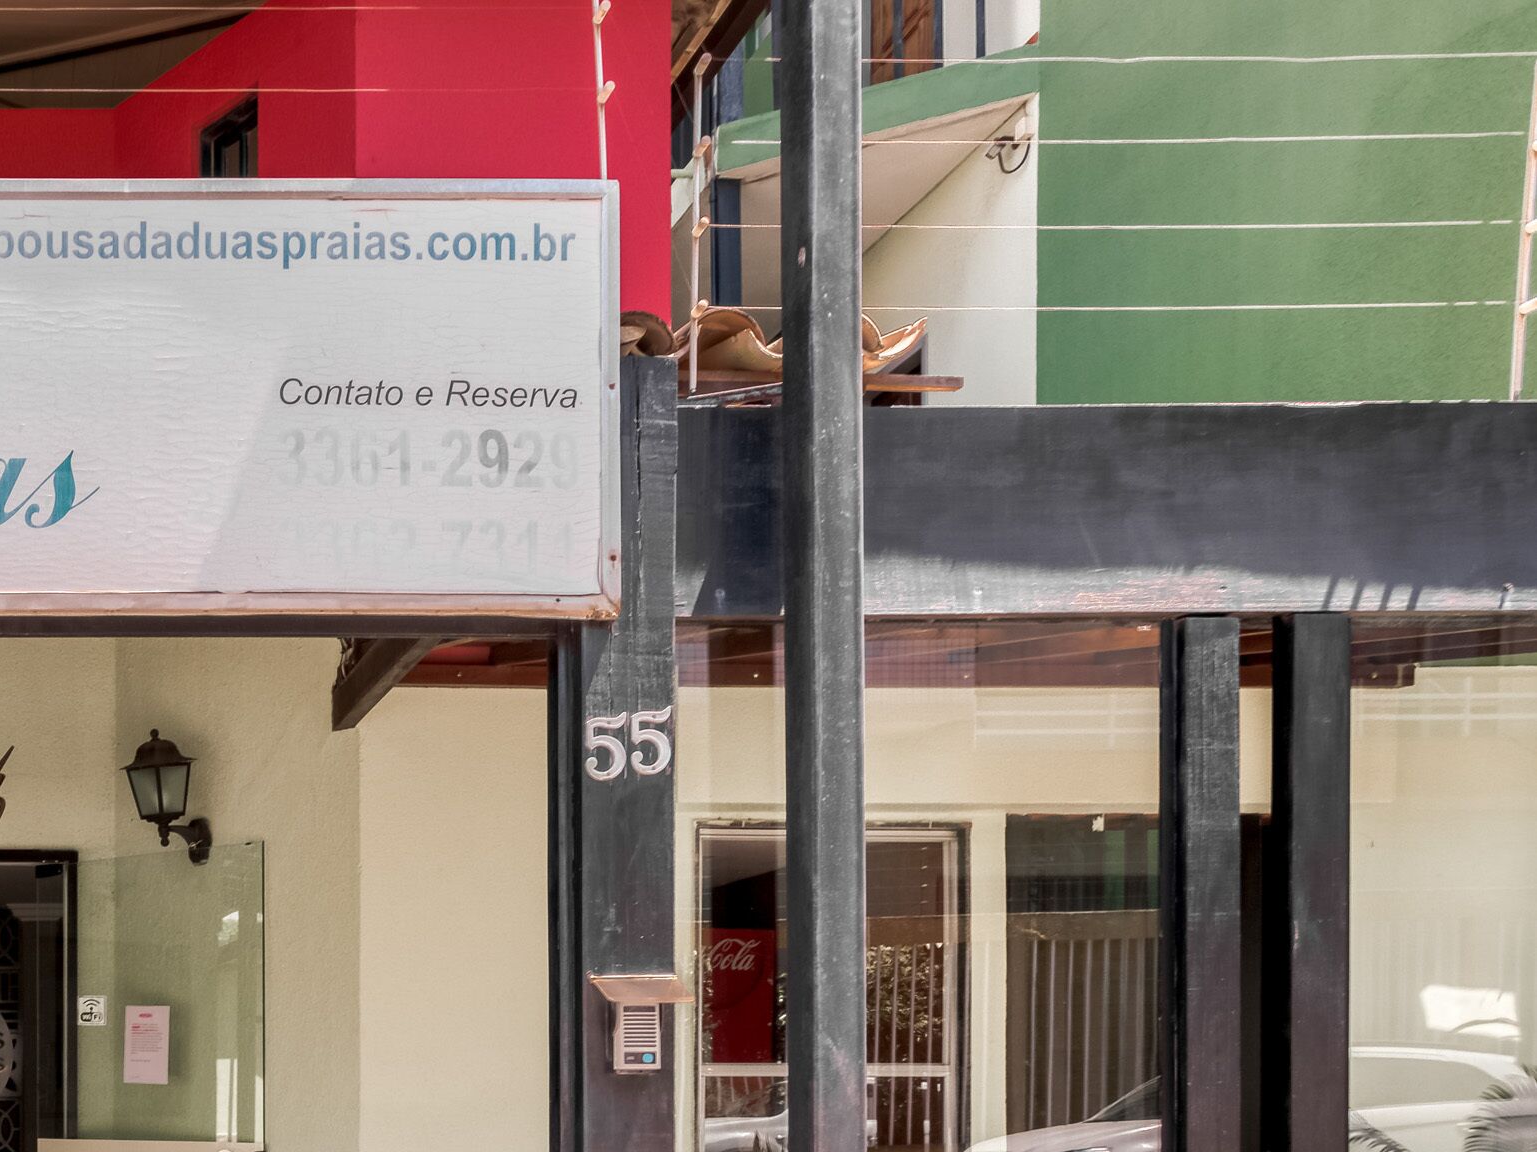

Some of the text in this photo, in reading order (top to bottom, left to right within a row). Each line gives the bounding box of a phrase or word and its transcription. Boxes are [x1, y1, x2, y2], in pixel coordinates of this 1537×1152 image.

[279, 377, 579, 410] Contato e Reserva
[278, 427, 579, 490] 3361-2929
[584, 705, 673, 782] 55
